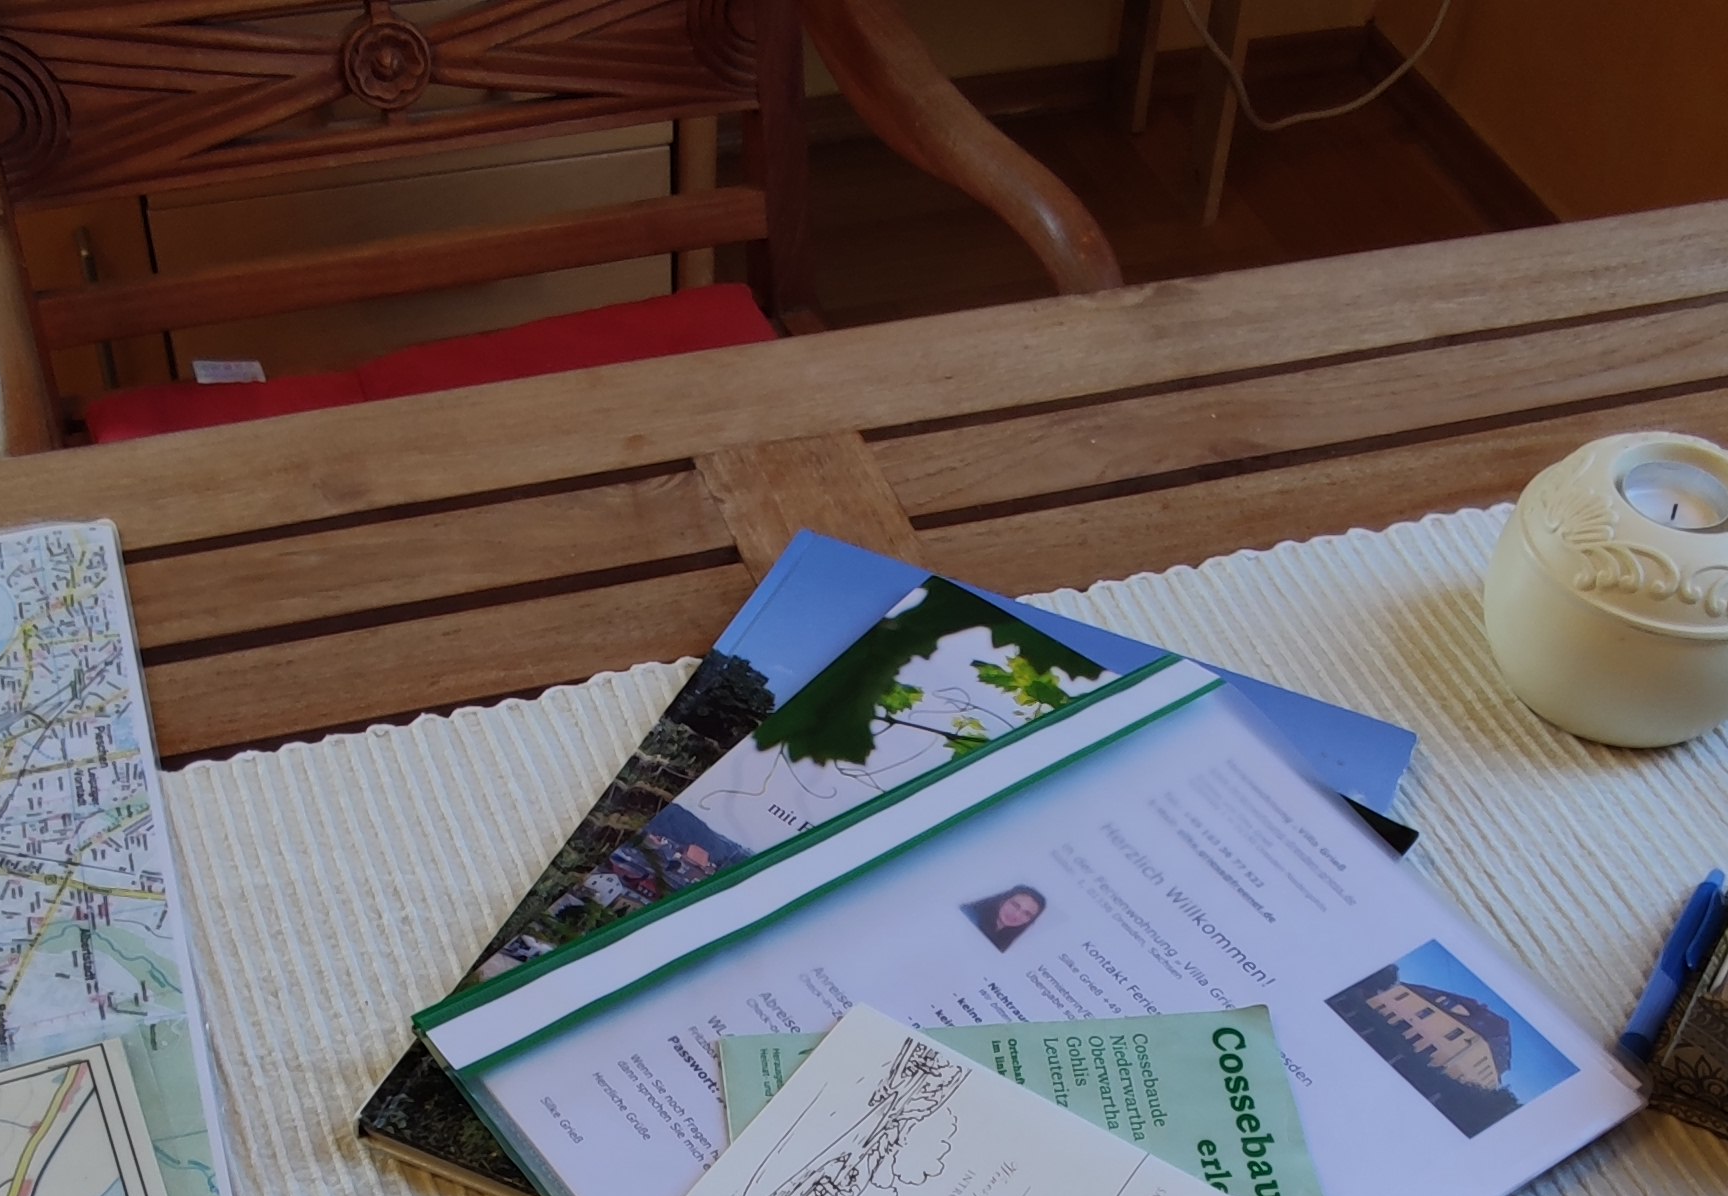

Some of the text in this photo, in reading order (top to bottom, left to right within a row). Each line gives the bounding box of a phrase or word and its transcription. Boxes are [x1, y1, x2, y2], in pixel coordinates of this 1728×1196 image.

[766, 801, 799, 827] mit
[1091, 871, 1179, 961] Ferienwohnung
[1098, 818, 1169, 888] Herzlich
[1162, 883, 1277, 991] Willkommen!
[811, 963, 855, 1012] Anreise
[1056, 950, 1123, 1017] Silke Grieß +49
[1079, 938, 1129, 986] Kontakt
[757, 988, 803, 1038] Abreise
[664, 1033, 722, 1097] Passwort:
[1042, 1035, 1070, 1109] Leuteritz
[1064, 1034, 1092, 1088] Gohlis
[1086, 1033, 1123, 1131] Oberwartha
[1108, 1032, 1148, 1142] Niederwartha
[1130, 1031, 1169, 1128] Cossebaude
[538, 1094, 584, 1146] Silke Grieß
[590, 1069, 653, 1143] Herzliche Grüße
[616, 1057, 640, 1084] dann
[633, 1080, 673, 1125] sprechen
[668, 1121, 687, 1141] Sie
[682, 1137, 707, 1164] mich
[628, 1052, 655, 1081] Wenn
[650, 1077, 668, 1097] Sie
[663, 1093, 686, 1119] noch
[682, 1116, 714, 1152] Fragen
[978, 1158, 1020, 1196] Wines
